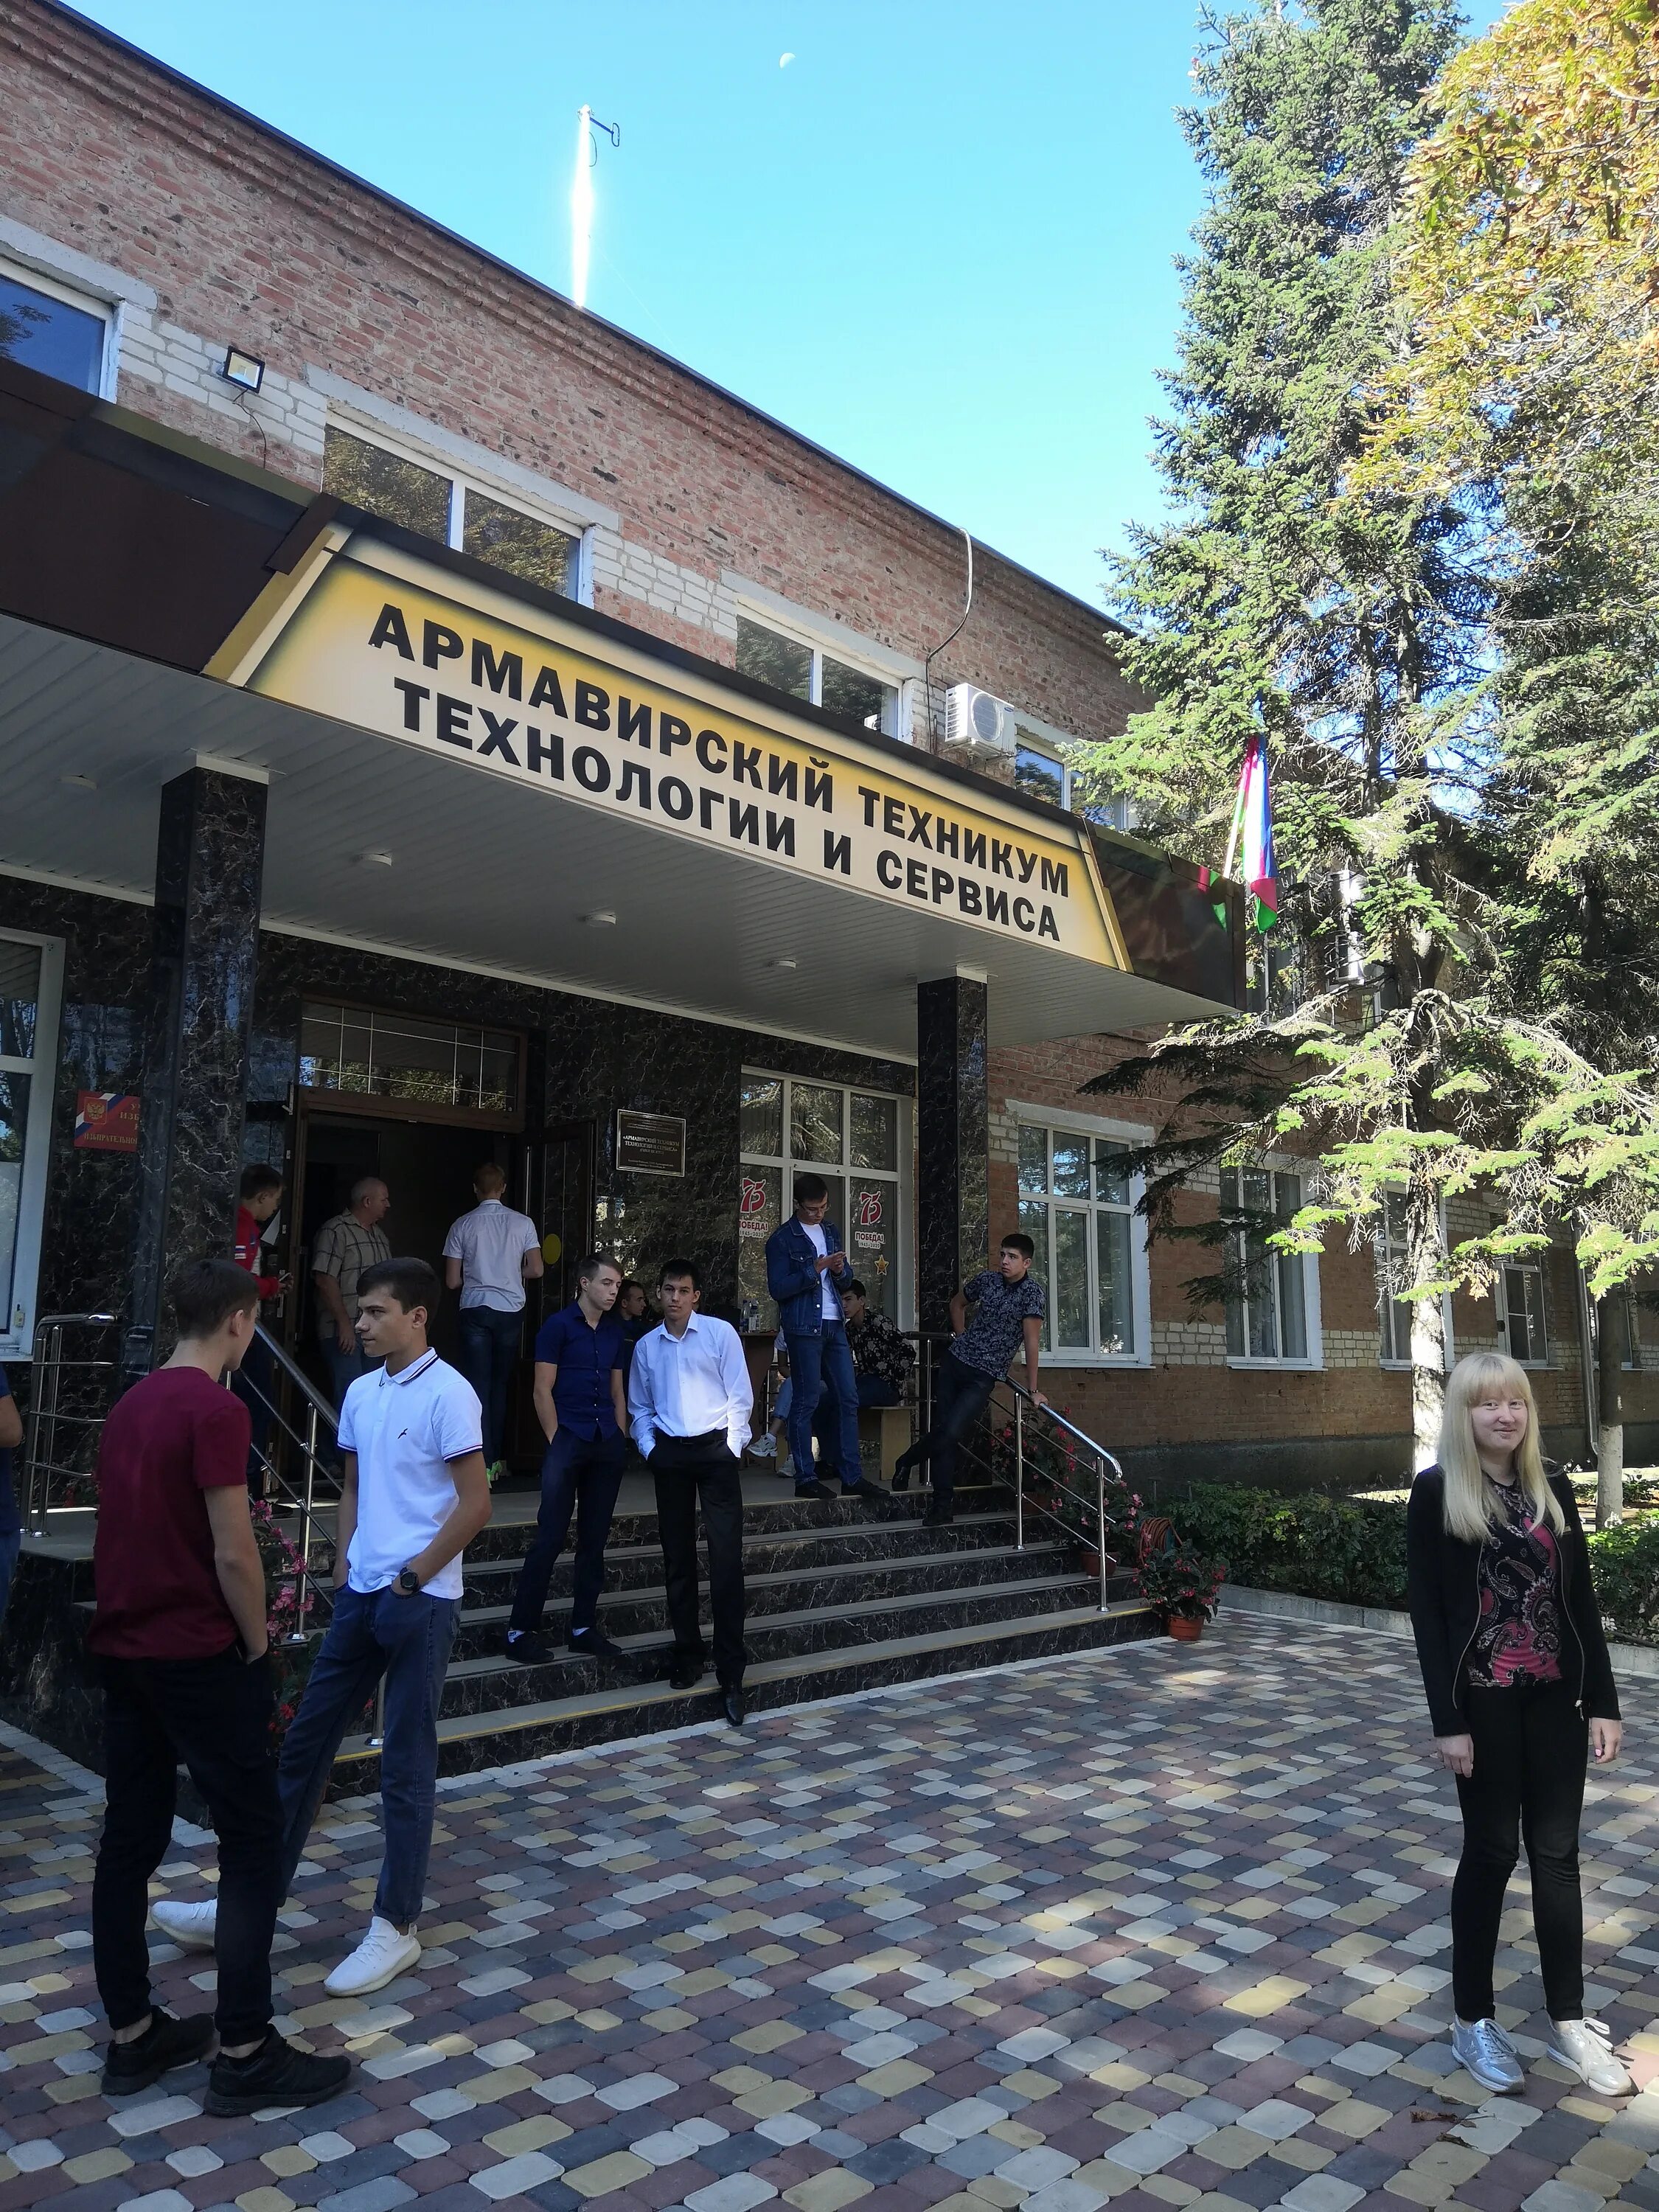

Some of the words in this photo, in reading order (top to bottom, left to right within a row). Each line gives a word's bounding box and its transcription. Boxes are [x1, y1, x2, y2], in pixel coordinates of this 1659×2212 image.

[368, 602, 833, 814] АРМАВИРСКИЙ
[858, 785, 1068, 898] ТЕХНИКУМ
[394, 676, 796, 858] ТЕХНОЛОГИИ
[824, 829, 851, 876] И
[877, 849, 1060, 942] СЕРВИСА
[740, 1178, 766, 1214] 75
[860, 1190, 882, 1225] 75
[856, 1232, 883, 1242] ПОБЕДА!
